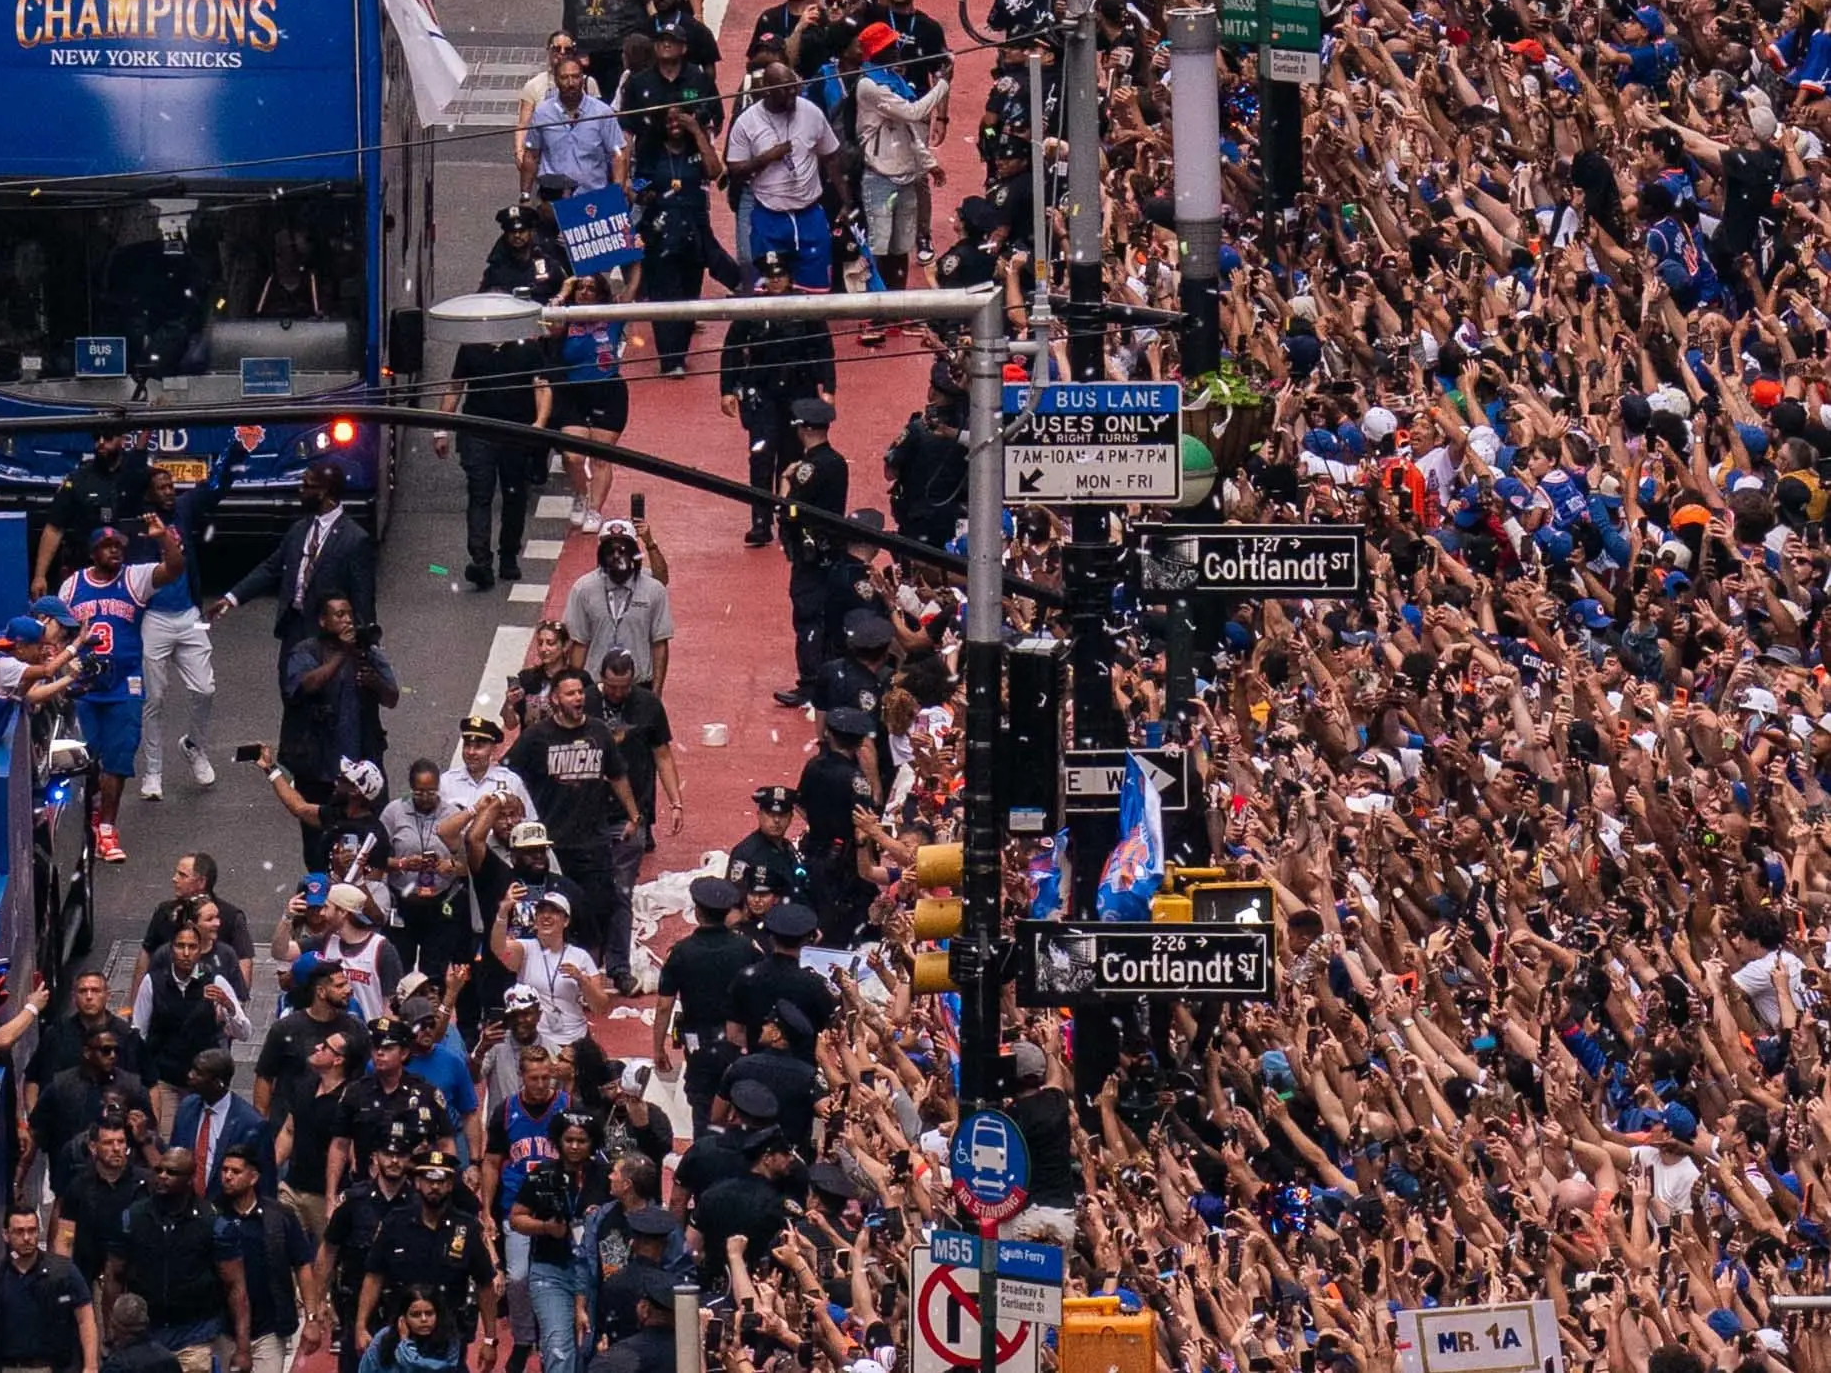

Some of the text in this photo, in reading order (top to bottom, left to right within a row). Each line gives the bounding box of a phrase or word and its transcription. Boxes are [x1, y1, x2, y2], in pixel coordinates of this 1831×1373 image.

[1224, 18, 1251, 37] MTA
[50, 48, 243, 68] NEW YORK KNICKS
[563, 211, 632, 245] WON FOR THE
[570, 231, 627, 263] BOROUGHS
[89, 344, 112, 355] BUS
[1056, 390, 1161, 408] BUS LANE
[1018, 414, 1168, 434] USES ONLY
[1042, 433, 1139, 443] & RIGHT TURNS
[1076, 474, 1111, 489] MON
[1127, 474, 1153, 489] FRI
[1253, 538, 1282, 553] 1-27
[1203, 551, 1350, 581] Cortlandt ST
[90, 621, 114, 655] 3
[548, 748, 604, 776] KNICKS
[1152, 935, 1187, 952] 2-26
[1102, 952, 1259, 983] Cortlandt ST
[957, 1187, 1019, 1220] NO STANDING
[934, 1236, 973, 1263] M55
[1024, 1248, 1046, 1265] Ferry
[1000, 1282, 1045, 1299] Broadway &
[1000, 1297, 1045, 1313] Cortlandt St
[1437, 1322, 1522, 1355] MR. 1A
